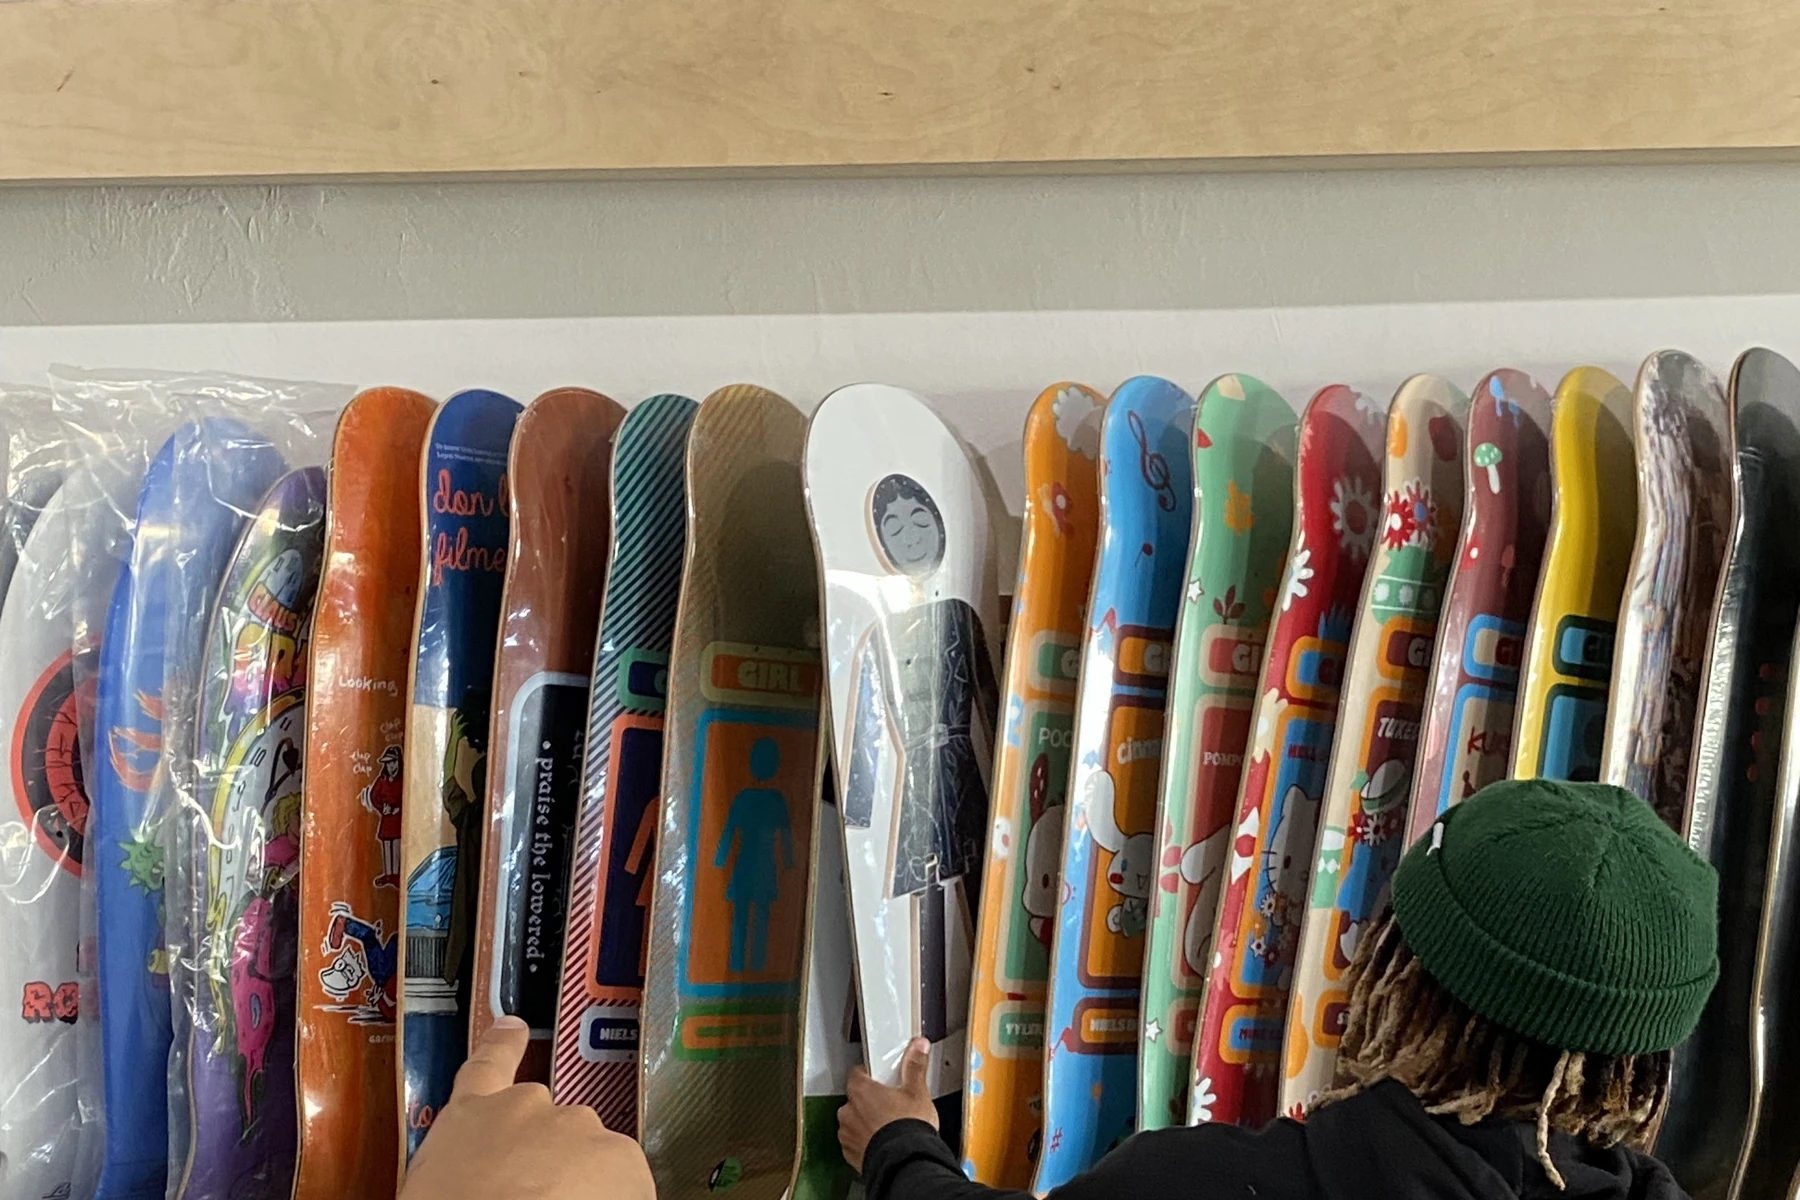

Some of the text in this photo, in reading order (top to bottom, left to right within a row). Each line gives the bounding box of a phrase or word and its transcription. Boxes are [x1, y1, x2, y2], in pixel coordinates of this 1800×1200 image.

[338, 675, 398, 697] Looking
[737, 660, 803, 692] GIRL
[526, 757, 555, 960] praise the lowered
[600, 1027, 639, 1041] NIELS
